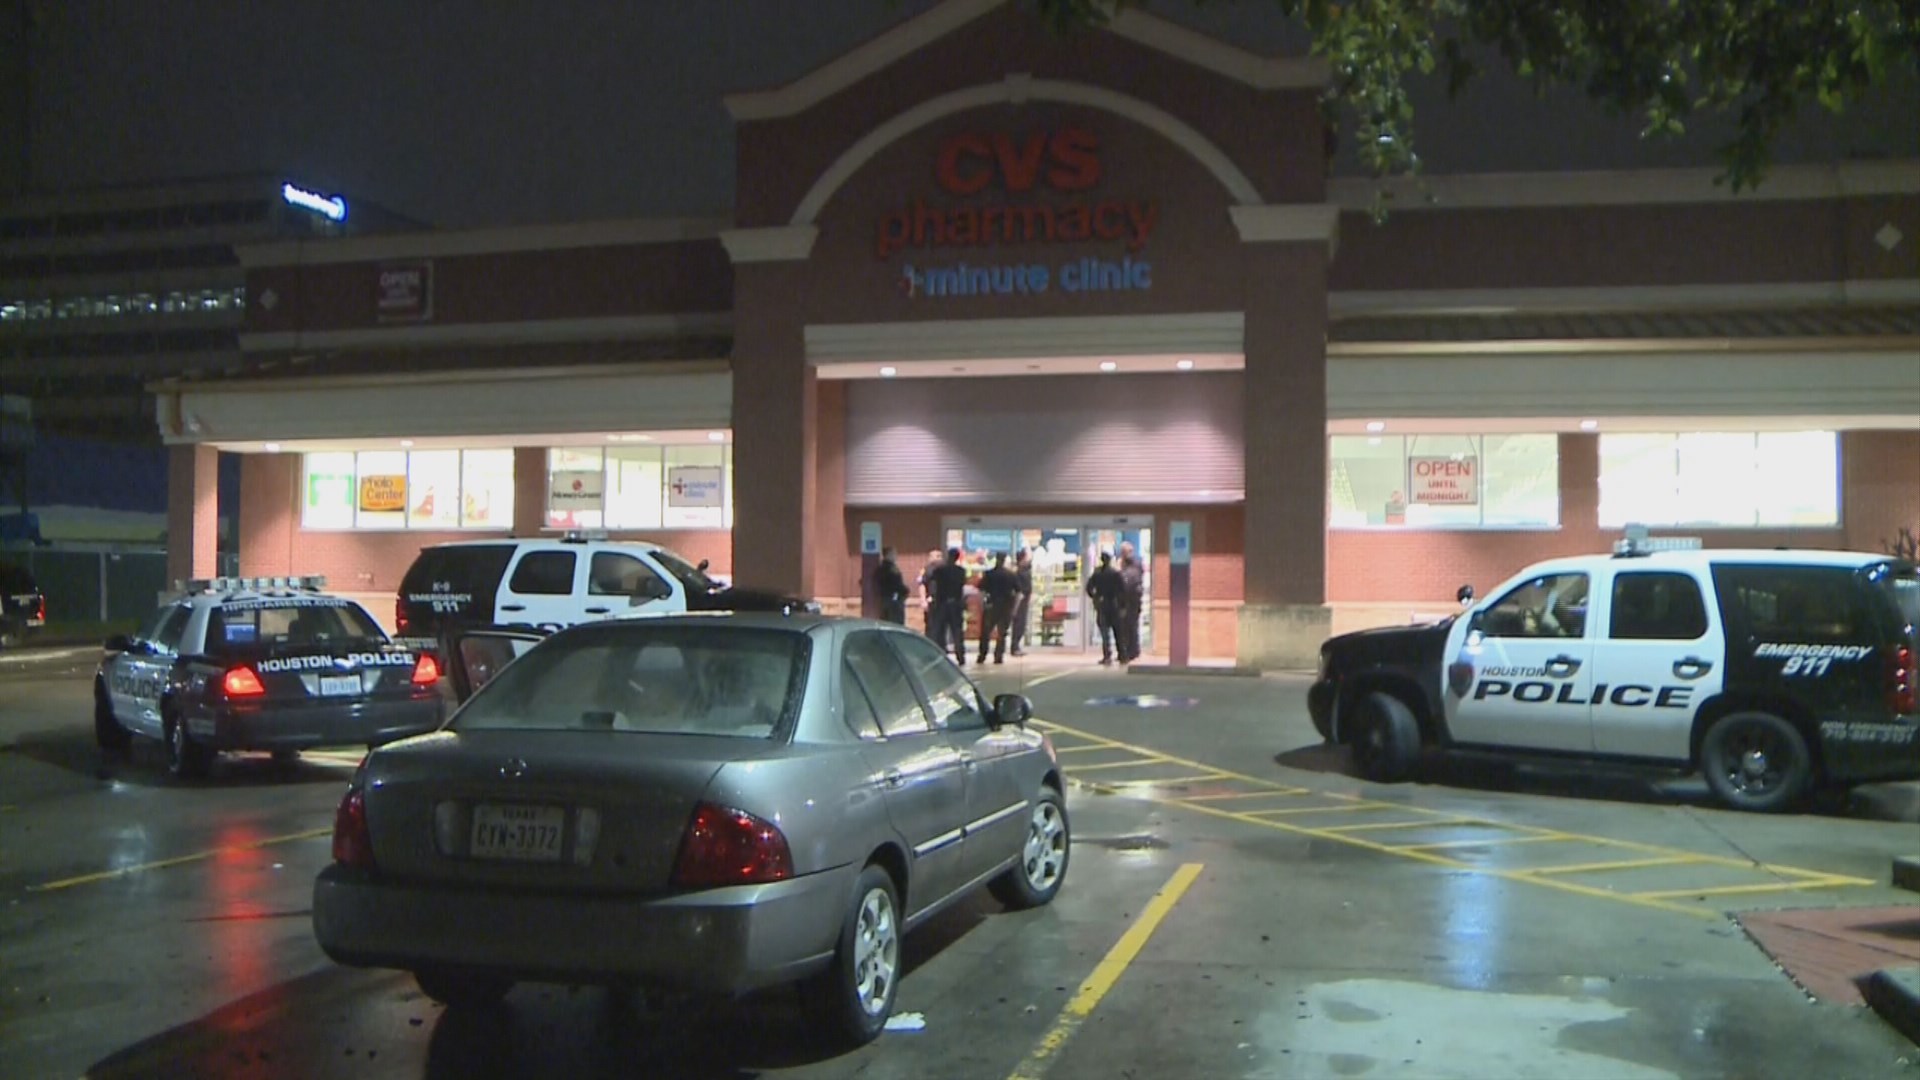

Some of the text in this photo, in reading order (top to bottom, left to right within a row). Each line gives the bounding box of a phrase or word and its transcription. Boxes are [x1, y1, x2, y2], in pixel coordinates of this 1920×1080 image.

[938, 129, 1101, 193] CVS
[878, 198, 1156, 260] pharmacy
[924, 256, 1152, 296] minute clinic
[1416, 460, 1471, 477] OPEN
[1428, 479, 1457, 489] UNTIL
[366, 488, 405, 501] Center
[409, 594, 472, 602] EMERGENCY
[433, 602, 459, 613] 911
[1754, 642, 1873, 660] EMERGENCY
[257, 652, 415, 672] HOUSTON POLICE
[1481, 665, 1548, 677] HOUSTON
[1781, 656, 1832, 676] 911
[1473, 680, 1695, 709] POLICE
